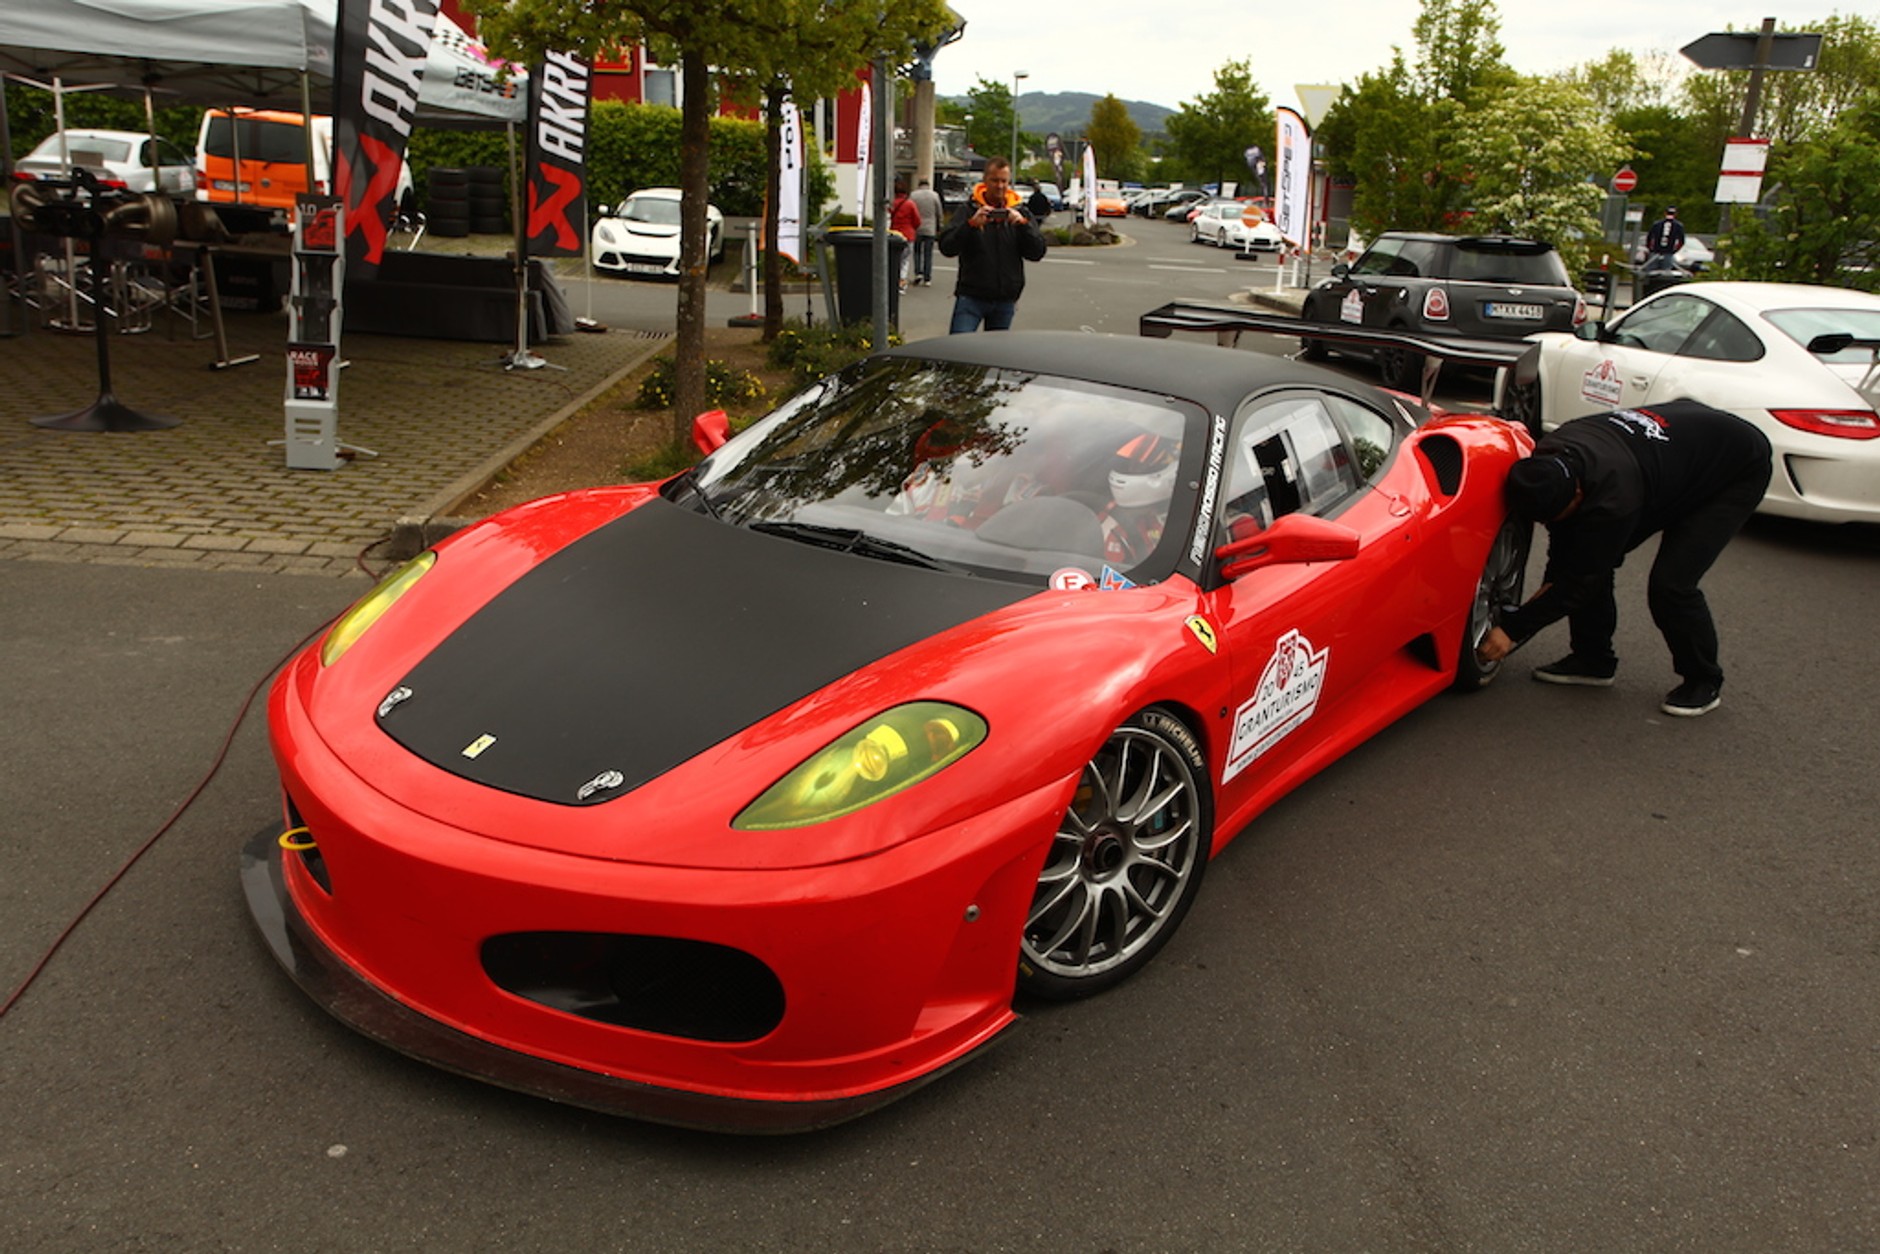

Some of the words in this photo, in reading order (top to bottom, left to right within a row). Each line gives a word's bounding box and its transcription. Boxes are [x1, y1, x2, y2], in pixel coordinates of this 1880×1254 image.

[362, 0, 440, 138] AKR
[1237, 672, 1320, 741] GRANTURISMO
[1159, 715, 1204, 768] MICHELIN
